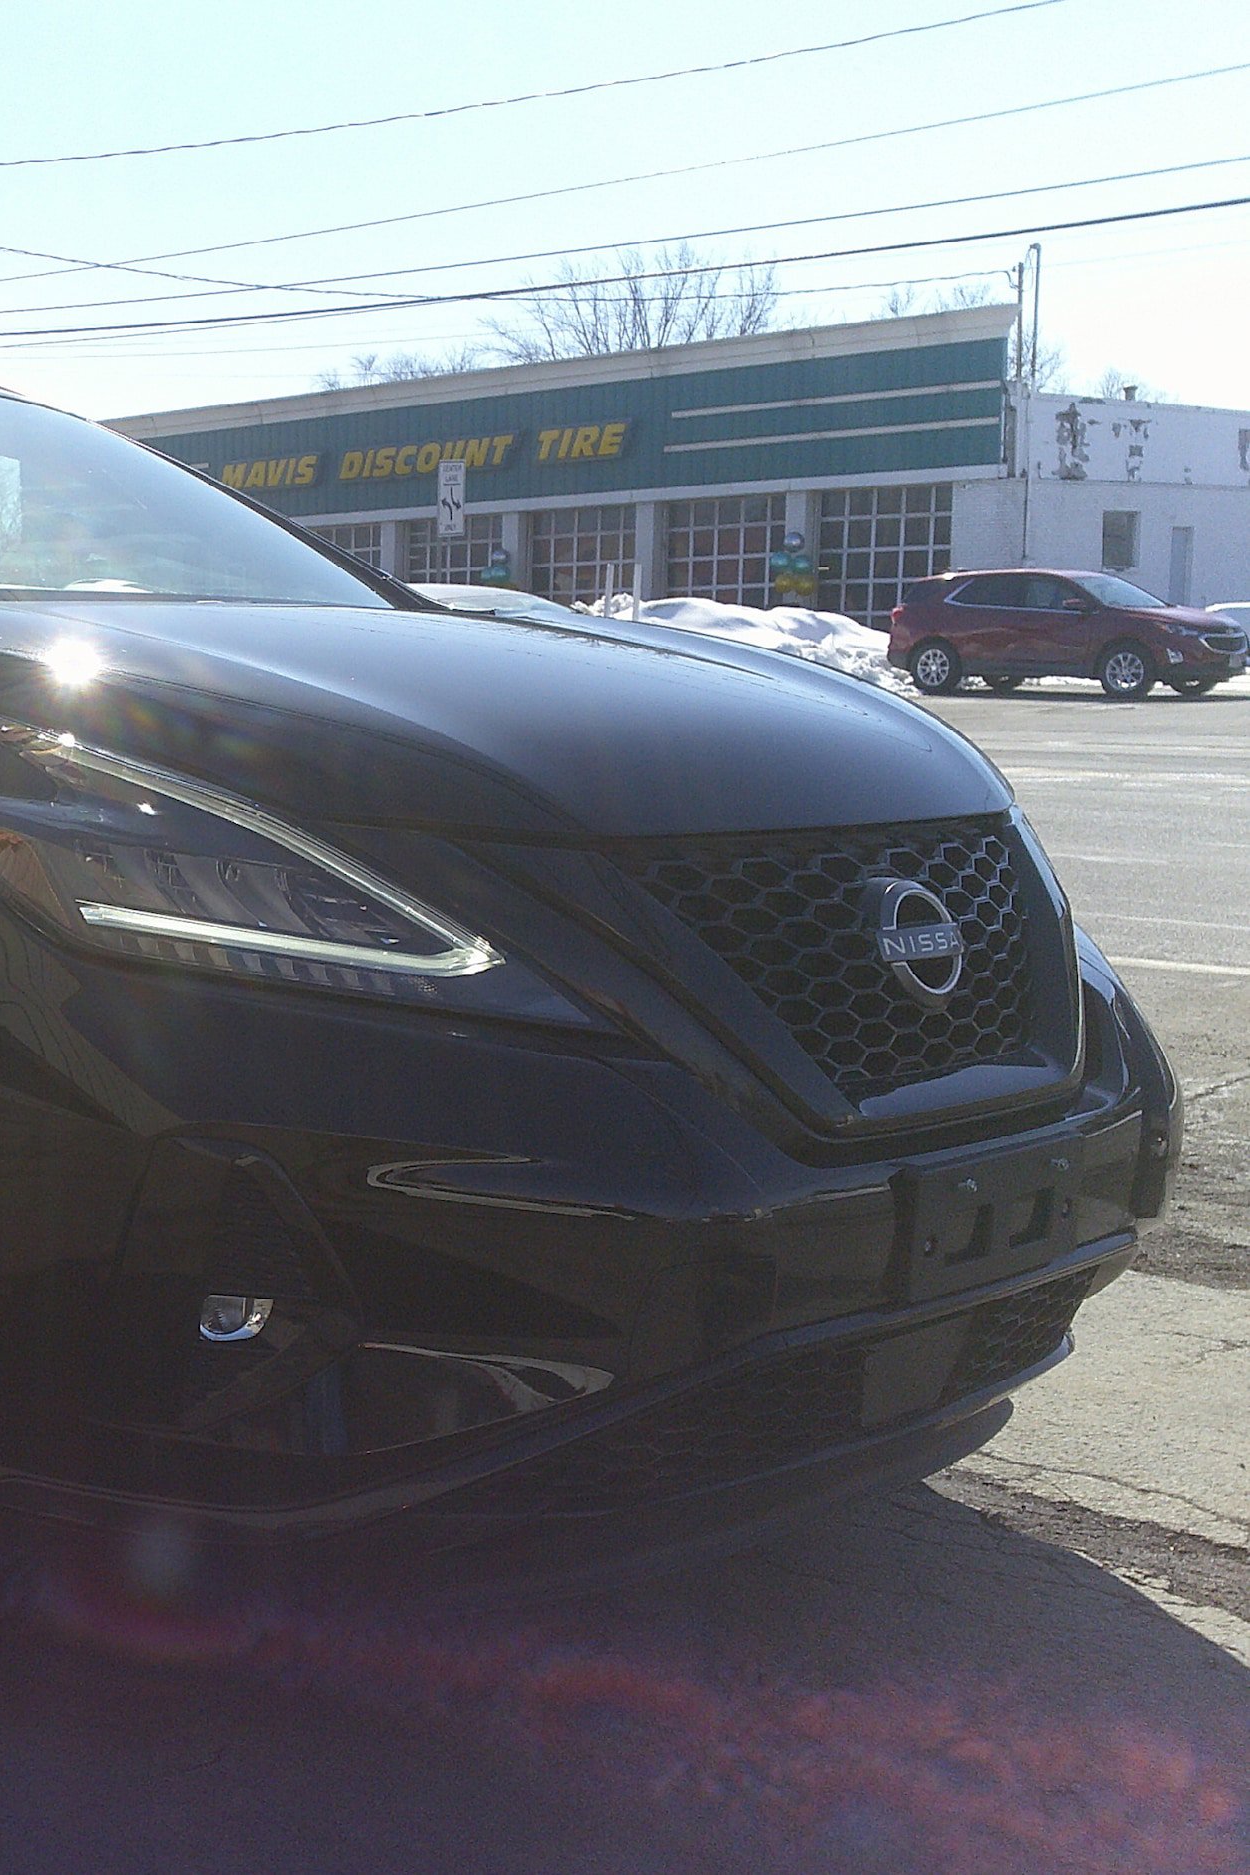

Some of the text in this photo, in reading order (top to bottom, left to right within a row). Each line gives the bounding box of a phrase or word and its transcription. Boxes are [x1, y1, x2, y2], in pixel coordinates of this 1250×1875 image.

[222, 423, 626, 488] MAVIS DISCOUNT TIRE
[882, 931, 960, 955] NISSA
